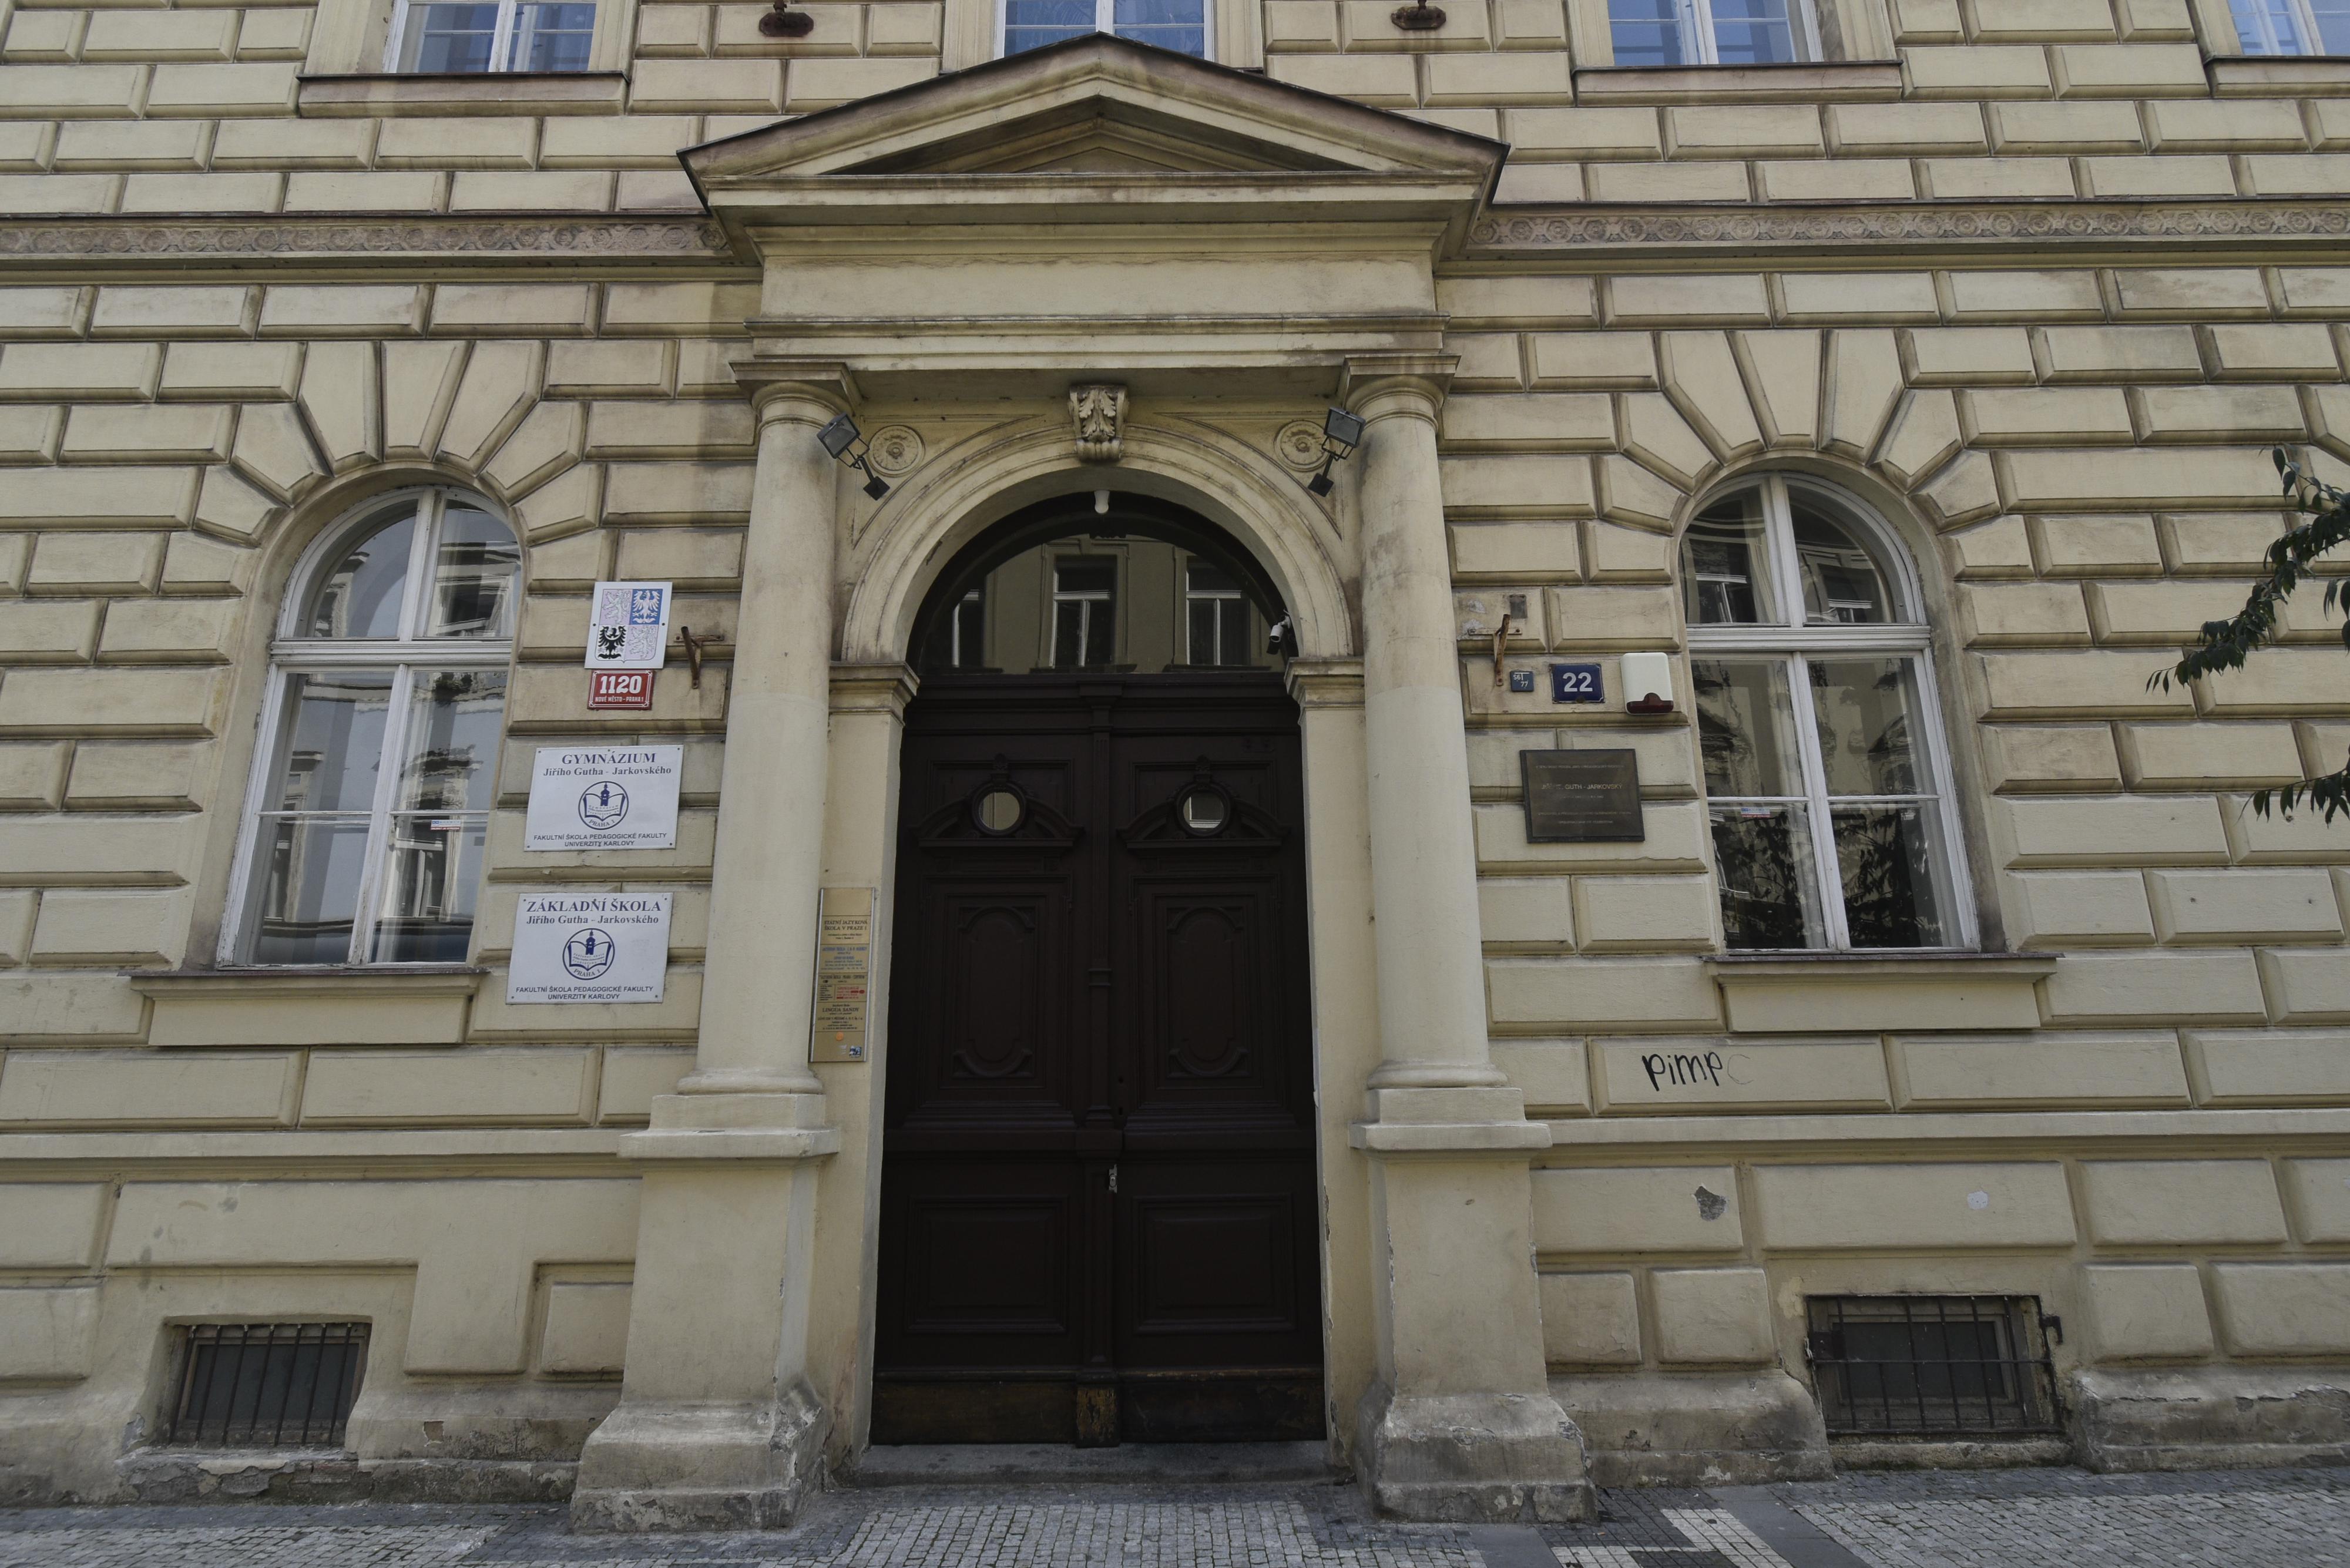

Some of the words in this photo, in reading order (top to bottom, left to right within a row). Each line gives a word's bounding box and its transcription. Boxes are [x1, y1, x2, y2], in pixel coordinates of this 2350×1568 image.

[600, 676, 642, 694] 1120
[1563, 672, 1593, 692] 22
[562, 751, 656, 764] GYMNÁZIUM
[543, 768, 571, 776] Jiřího
[574, 767, 603, 776] Gutha
[612, 766, 672, 775] Jarkovského
[526, 898, 607, 912] ZÁKLADNÍ
[610, 898, 661, 911] ŠKOLA
[526, 916, 555, 924] Jiřího
[558, 915, 588, 924] Gutha
[597, 915, 659, 924] Jarkovského
[573, 968, 595, 976] PRAHA
[1641, 1052, 1723, 1092] pimp
